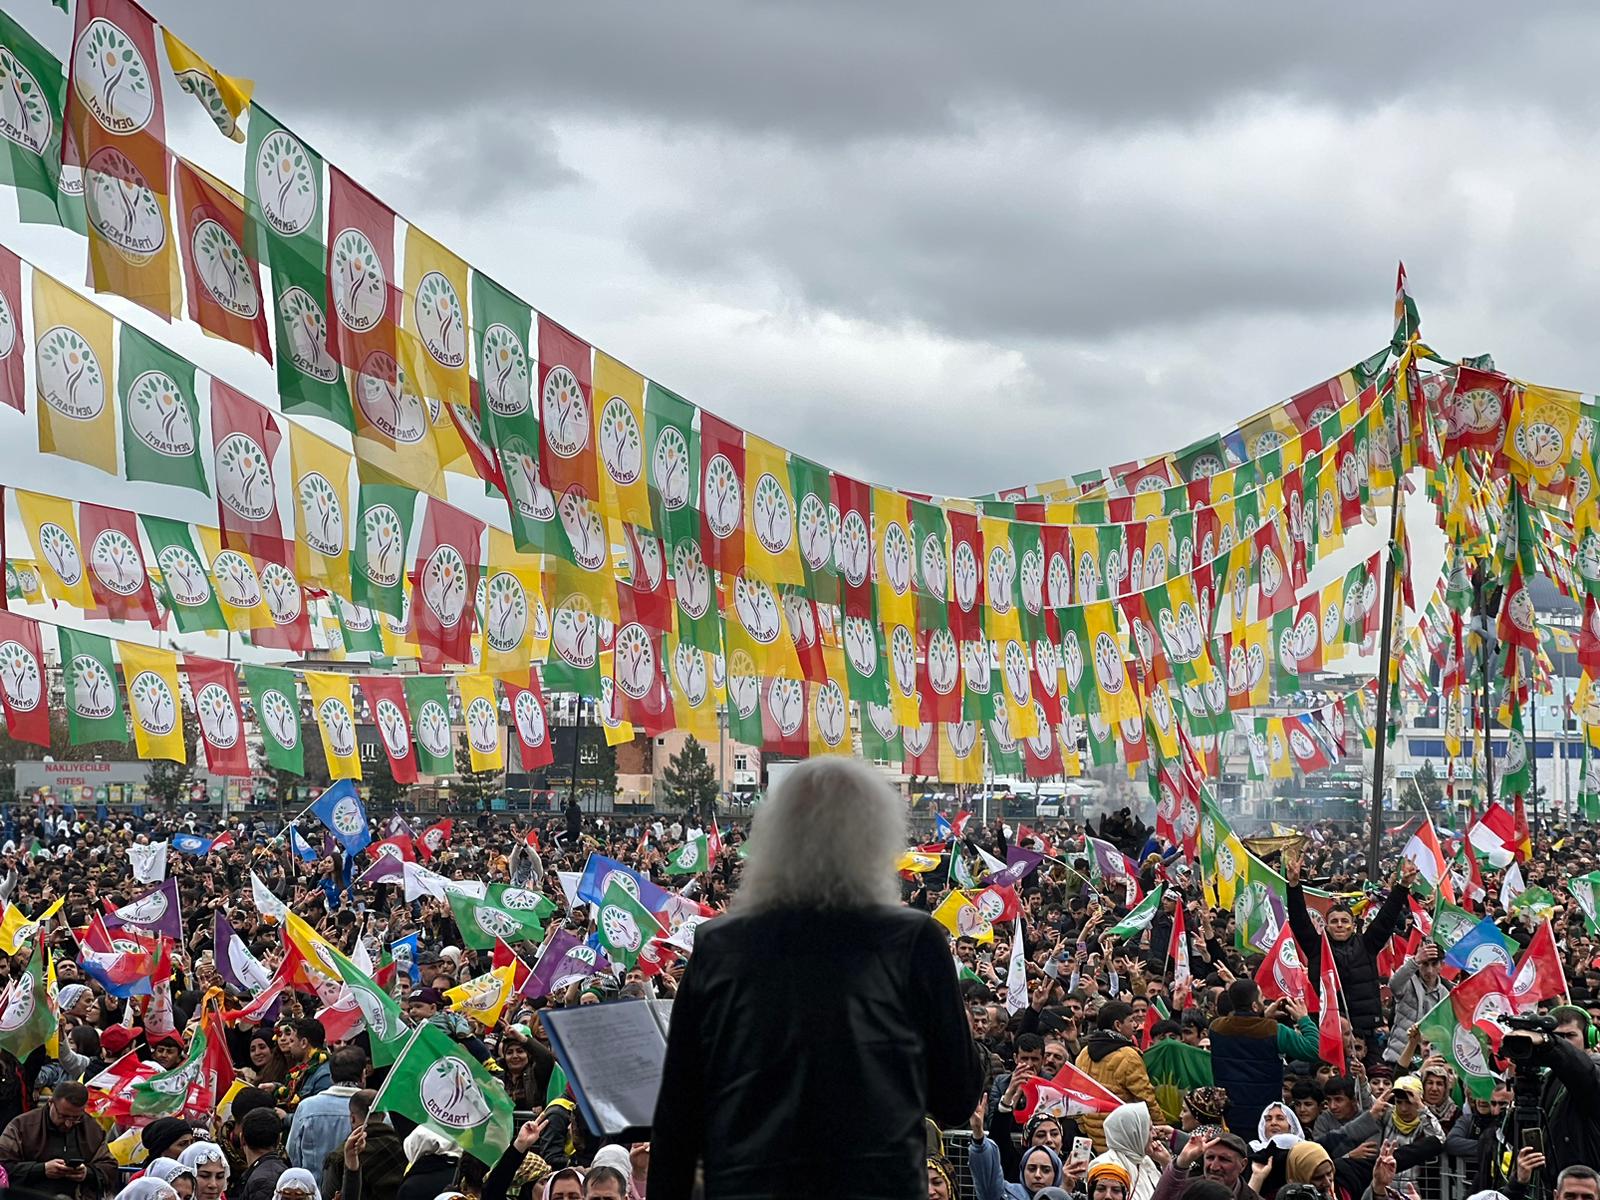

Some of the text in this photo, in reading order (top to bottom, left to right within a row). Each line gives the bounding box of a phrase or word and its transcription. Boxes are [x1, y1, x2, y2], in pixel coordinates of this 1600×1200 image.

[99, 220, 154, 249] DEM PARTİ
[212, 286, 231, 306] DEM
[292, 353, 315, 373] DEM
[376, 417, 419, 440] DEM PARTİ
[535, 505, 553, 517] PARTİ
[176, 594, 191, 603] DEM
[229, 596, 244, 605] DEM
[372, 1008, 383, 1025] DEM
[427, 1098, 470, 1124] DEM PARTİ
